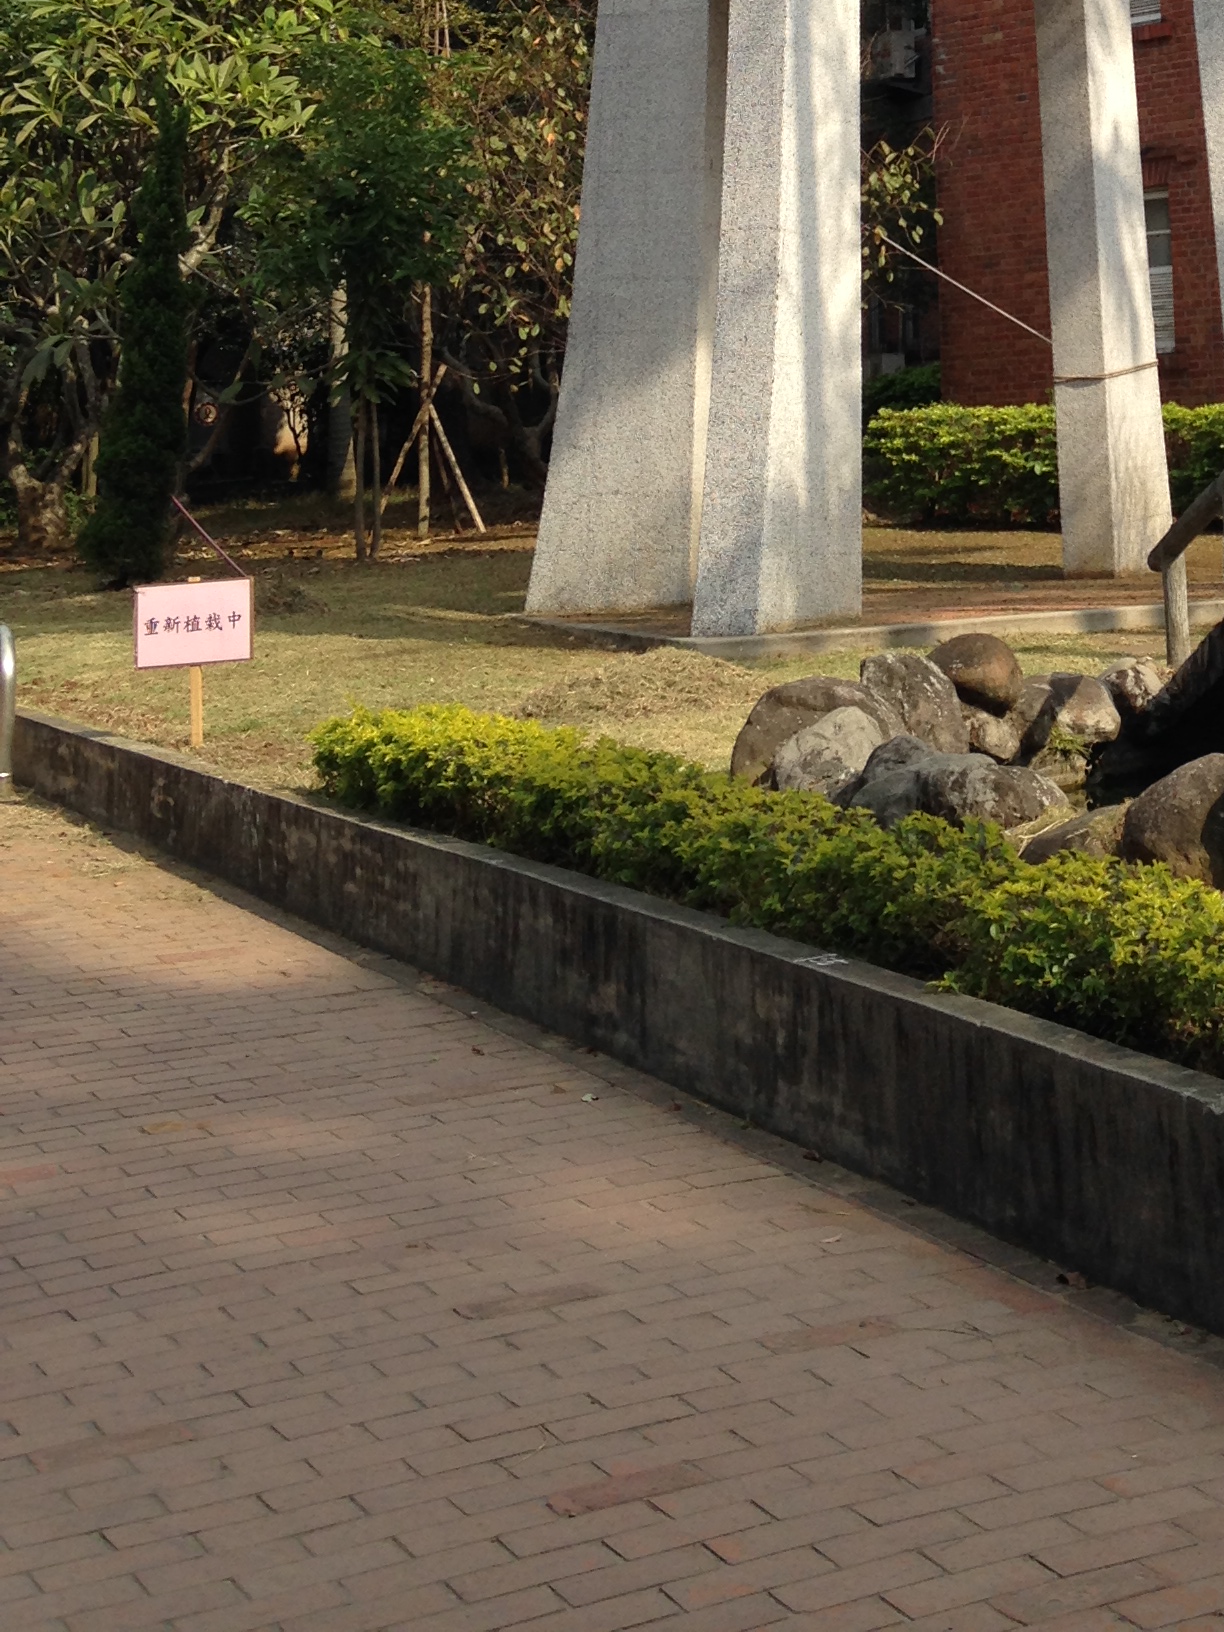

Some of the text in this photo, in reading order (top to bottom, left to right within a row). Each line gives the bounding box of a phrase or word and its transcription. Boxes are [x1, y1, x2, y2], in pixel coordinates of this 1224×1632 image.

[144, 610, 242, 636] 重新植栽中
